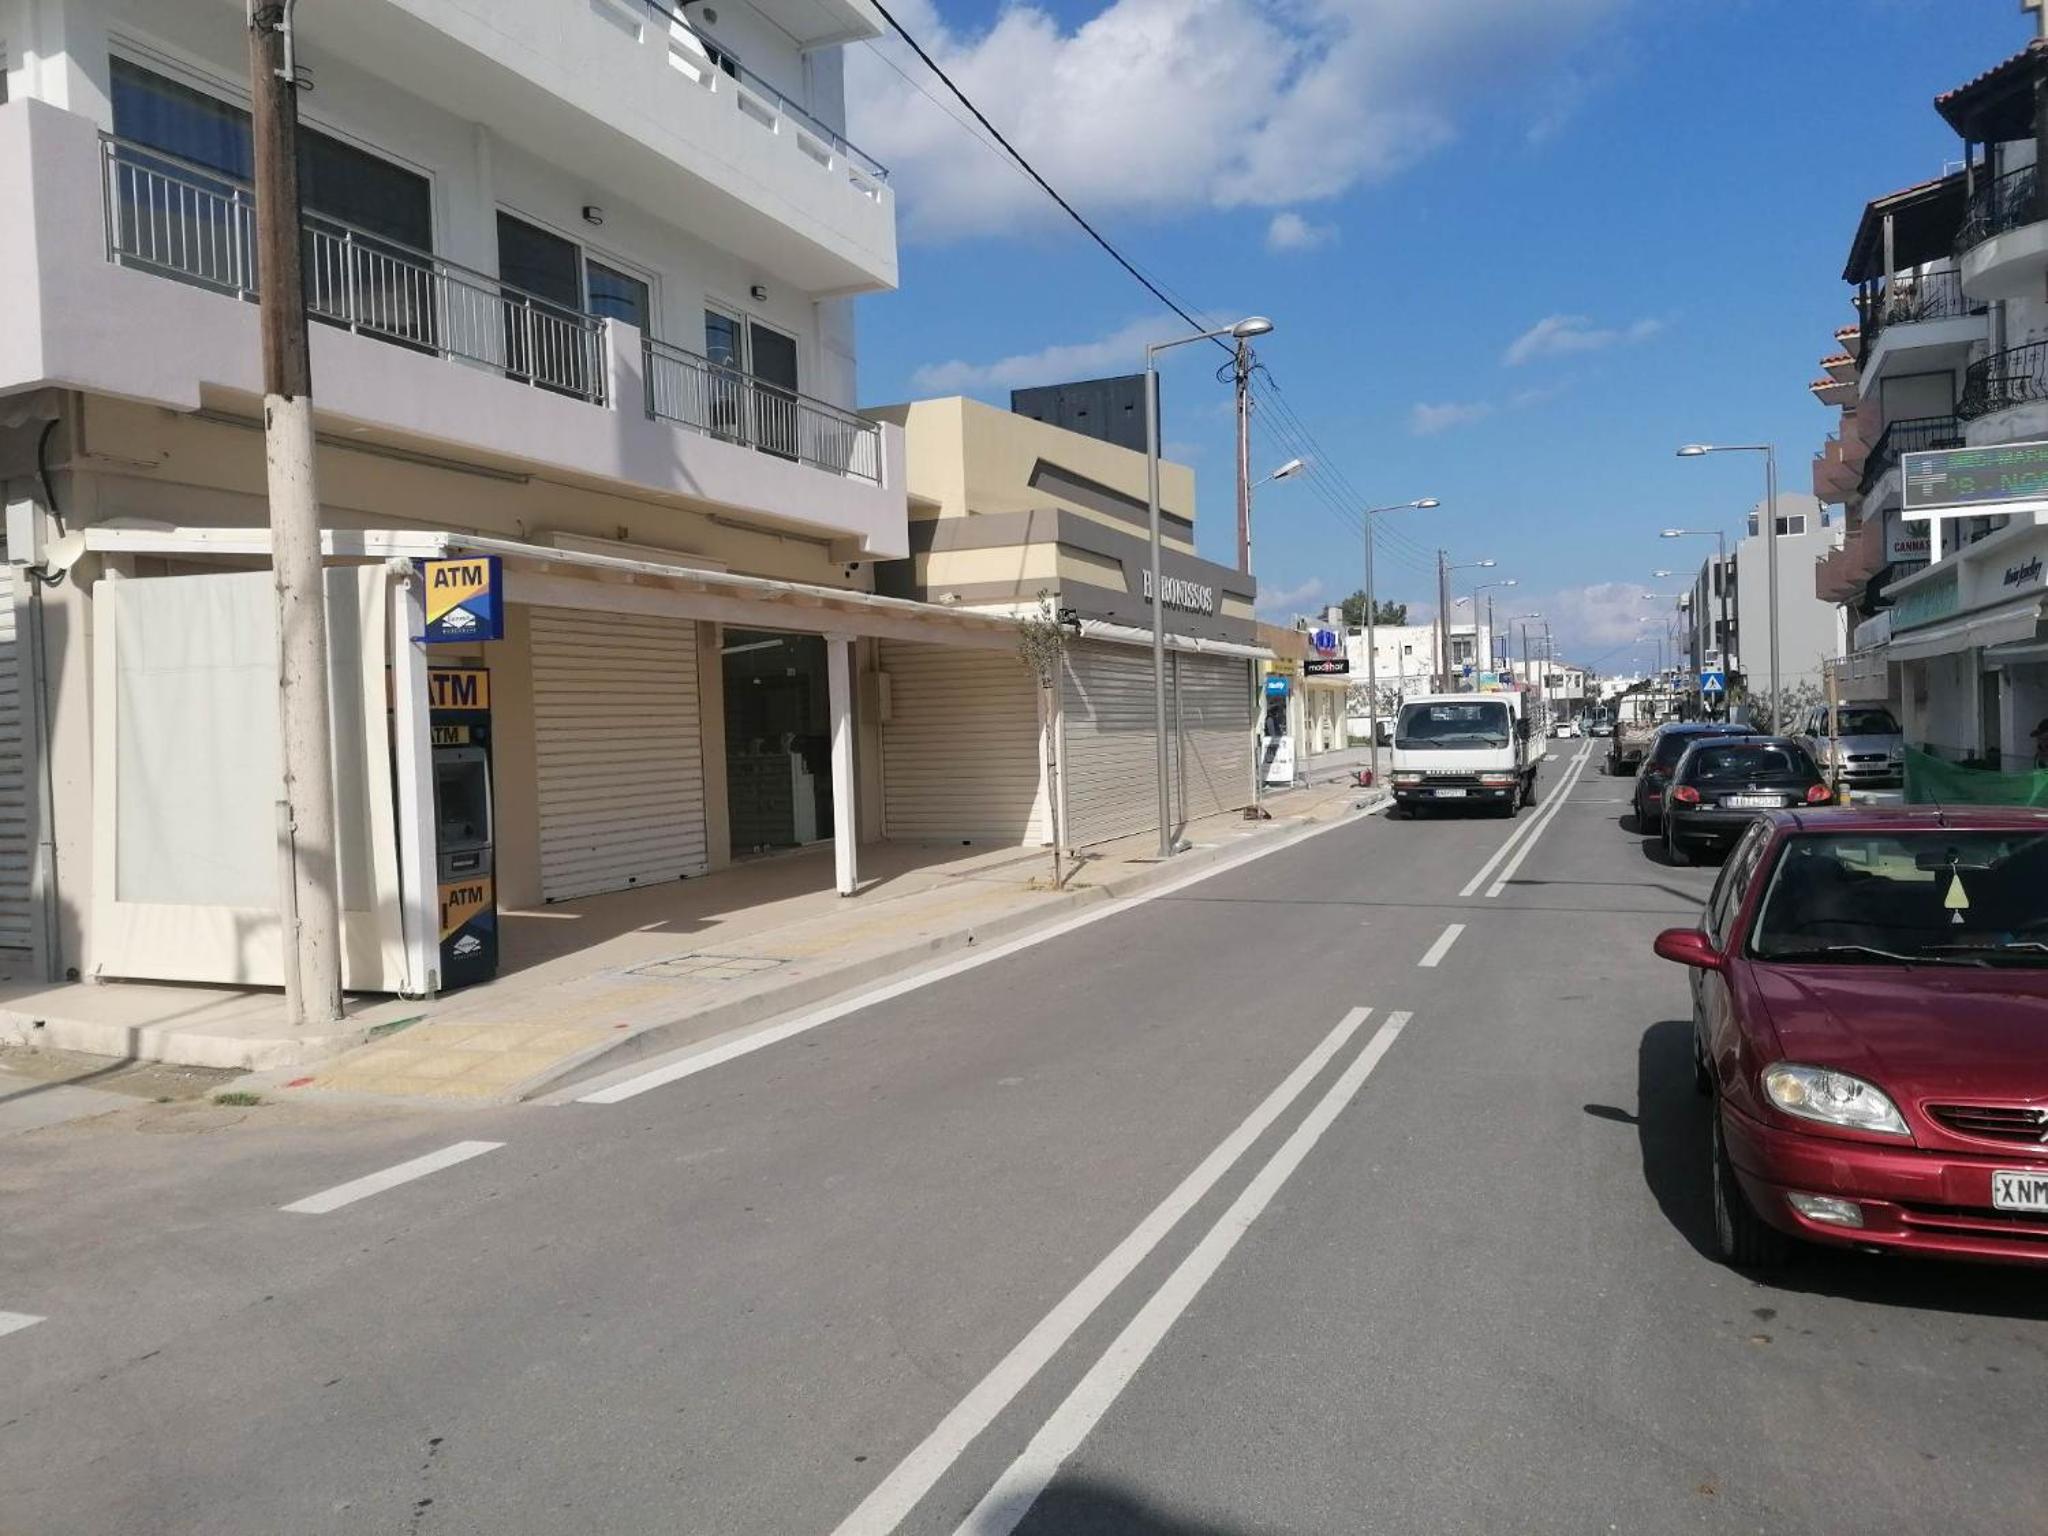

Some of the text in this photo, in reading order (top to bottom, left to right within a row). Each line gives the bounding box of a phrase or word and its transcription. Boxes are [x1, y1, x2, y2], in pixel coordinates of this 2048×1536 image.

[434, 566, 482, 588] ATM
[1143, 569, 1212, 611] BRONISSOS
[449, 886, 482, 908] ATM
